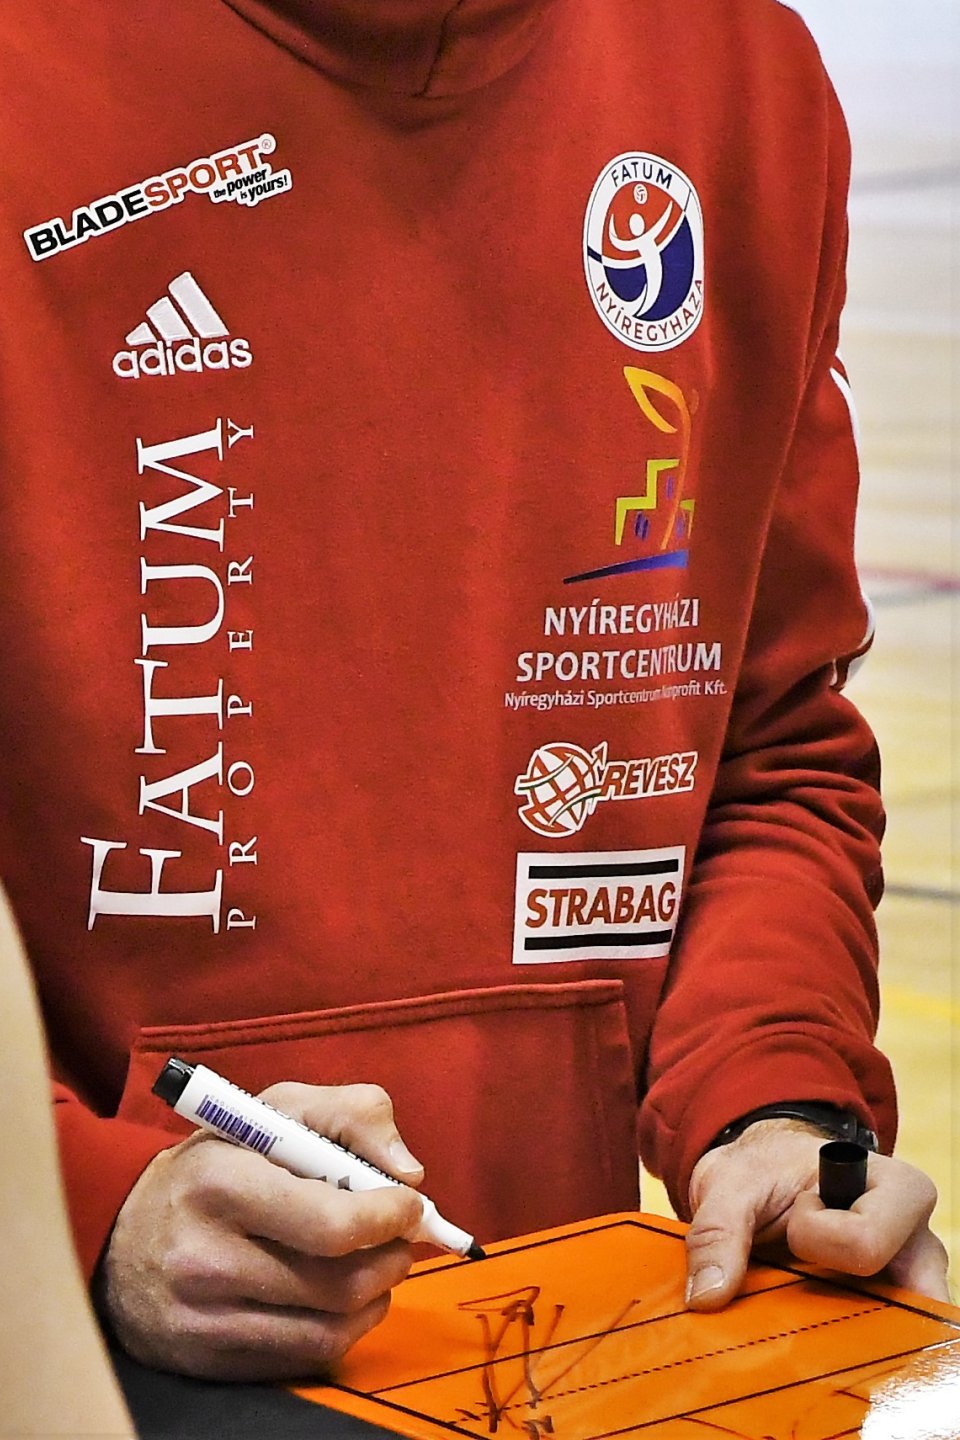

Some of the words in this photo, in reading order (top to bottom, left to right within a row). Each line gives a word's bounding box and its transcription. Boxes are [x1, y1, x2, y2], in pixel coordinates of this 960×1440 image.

[213, 188, 227, 199] the
[226, 168, 268, 197] power
[240, 190, 248, 200] is
[248, 174, 289, 202] yours!
[611, 161, 673, 189] FATUM
[28, 144, 260, 257] BLADESPORT
[596, 279, 703, 342] NYÍREGYHÁZA
[112, 336, 253, 379] adidas
[543, 593, 700, 636] NYÍREGYHÁZI
[80, 417, 225, 935] FATUM
[226, 418, 258, 931] PROPERTY
[515, 642, 722, 683] SPORTCENTRUM
[504, 688, 584, 711] Nyíregyházi
[704, 679, 728, 696] Kft.
[525, 881, 676, 929] STRABAG
